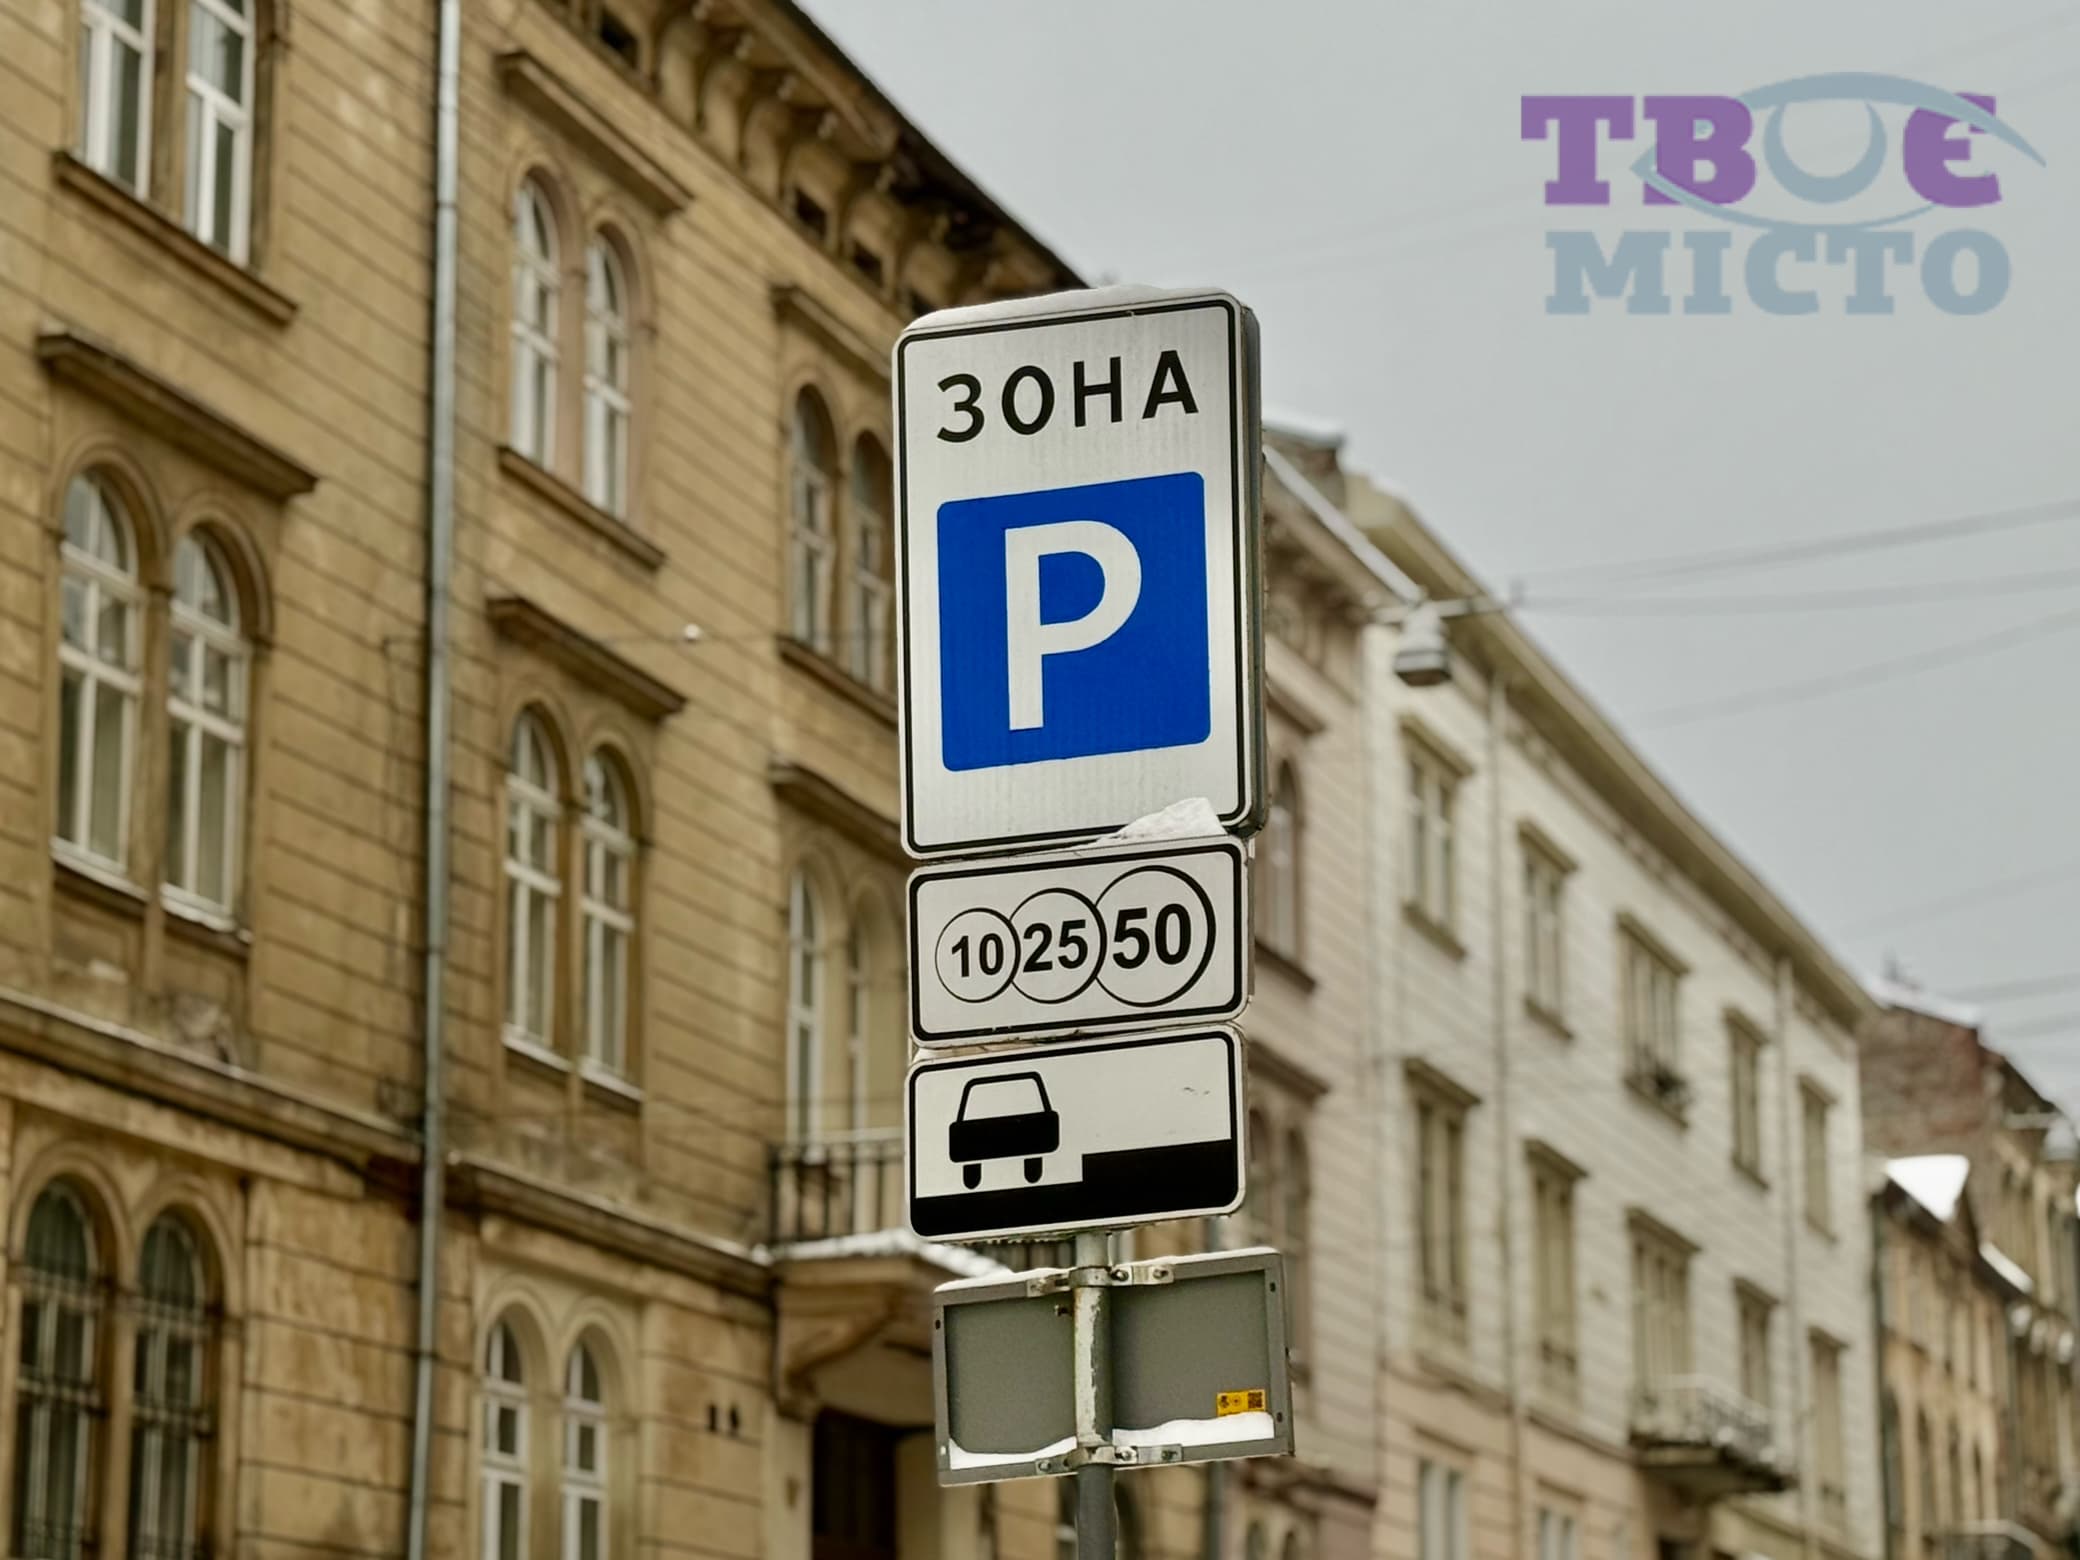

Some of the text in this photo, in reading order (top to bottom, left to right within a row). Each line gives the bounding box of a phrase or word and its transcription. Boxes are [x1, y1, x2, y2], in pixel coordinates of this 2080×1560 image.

[936, 349, 1199, 443] ЗОНА
[1004, 519, 1142, 731] P
[951, 903, 1192, 978] 10 25 50
